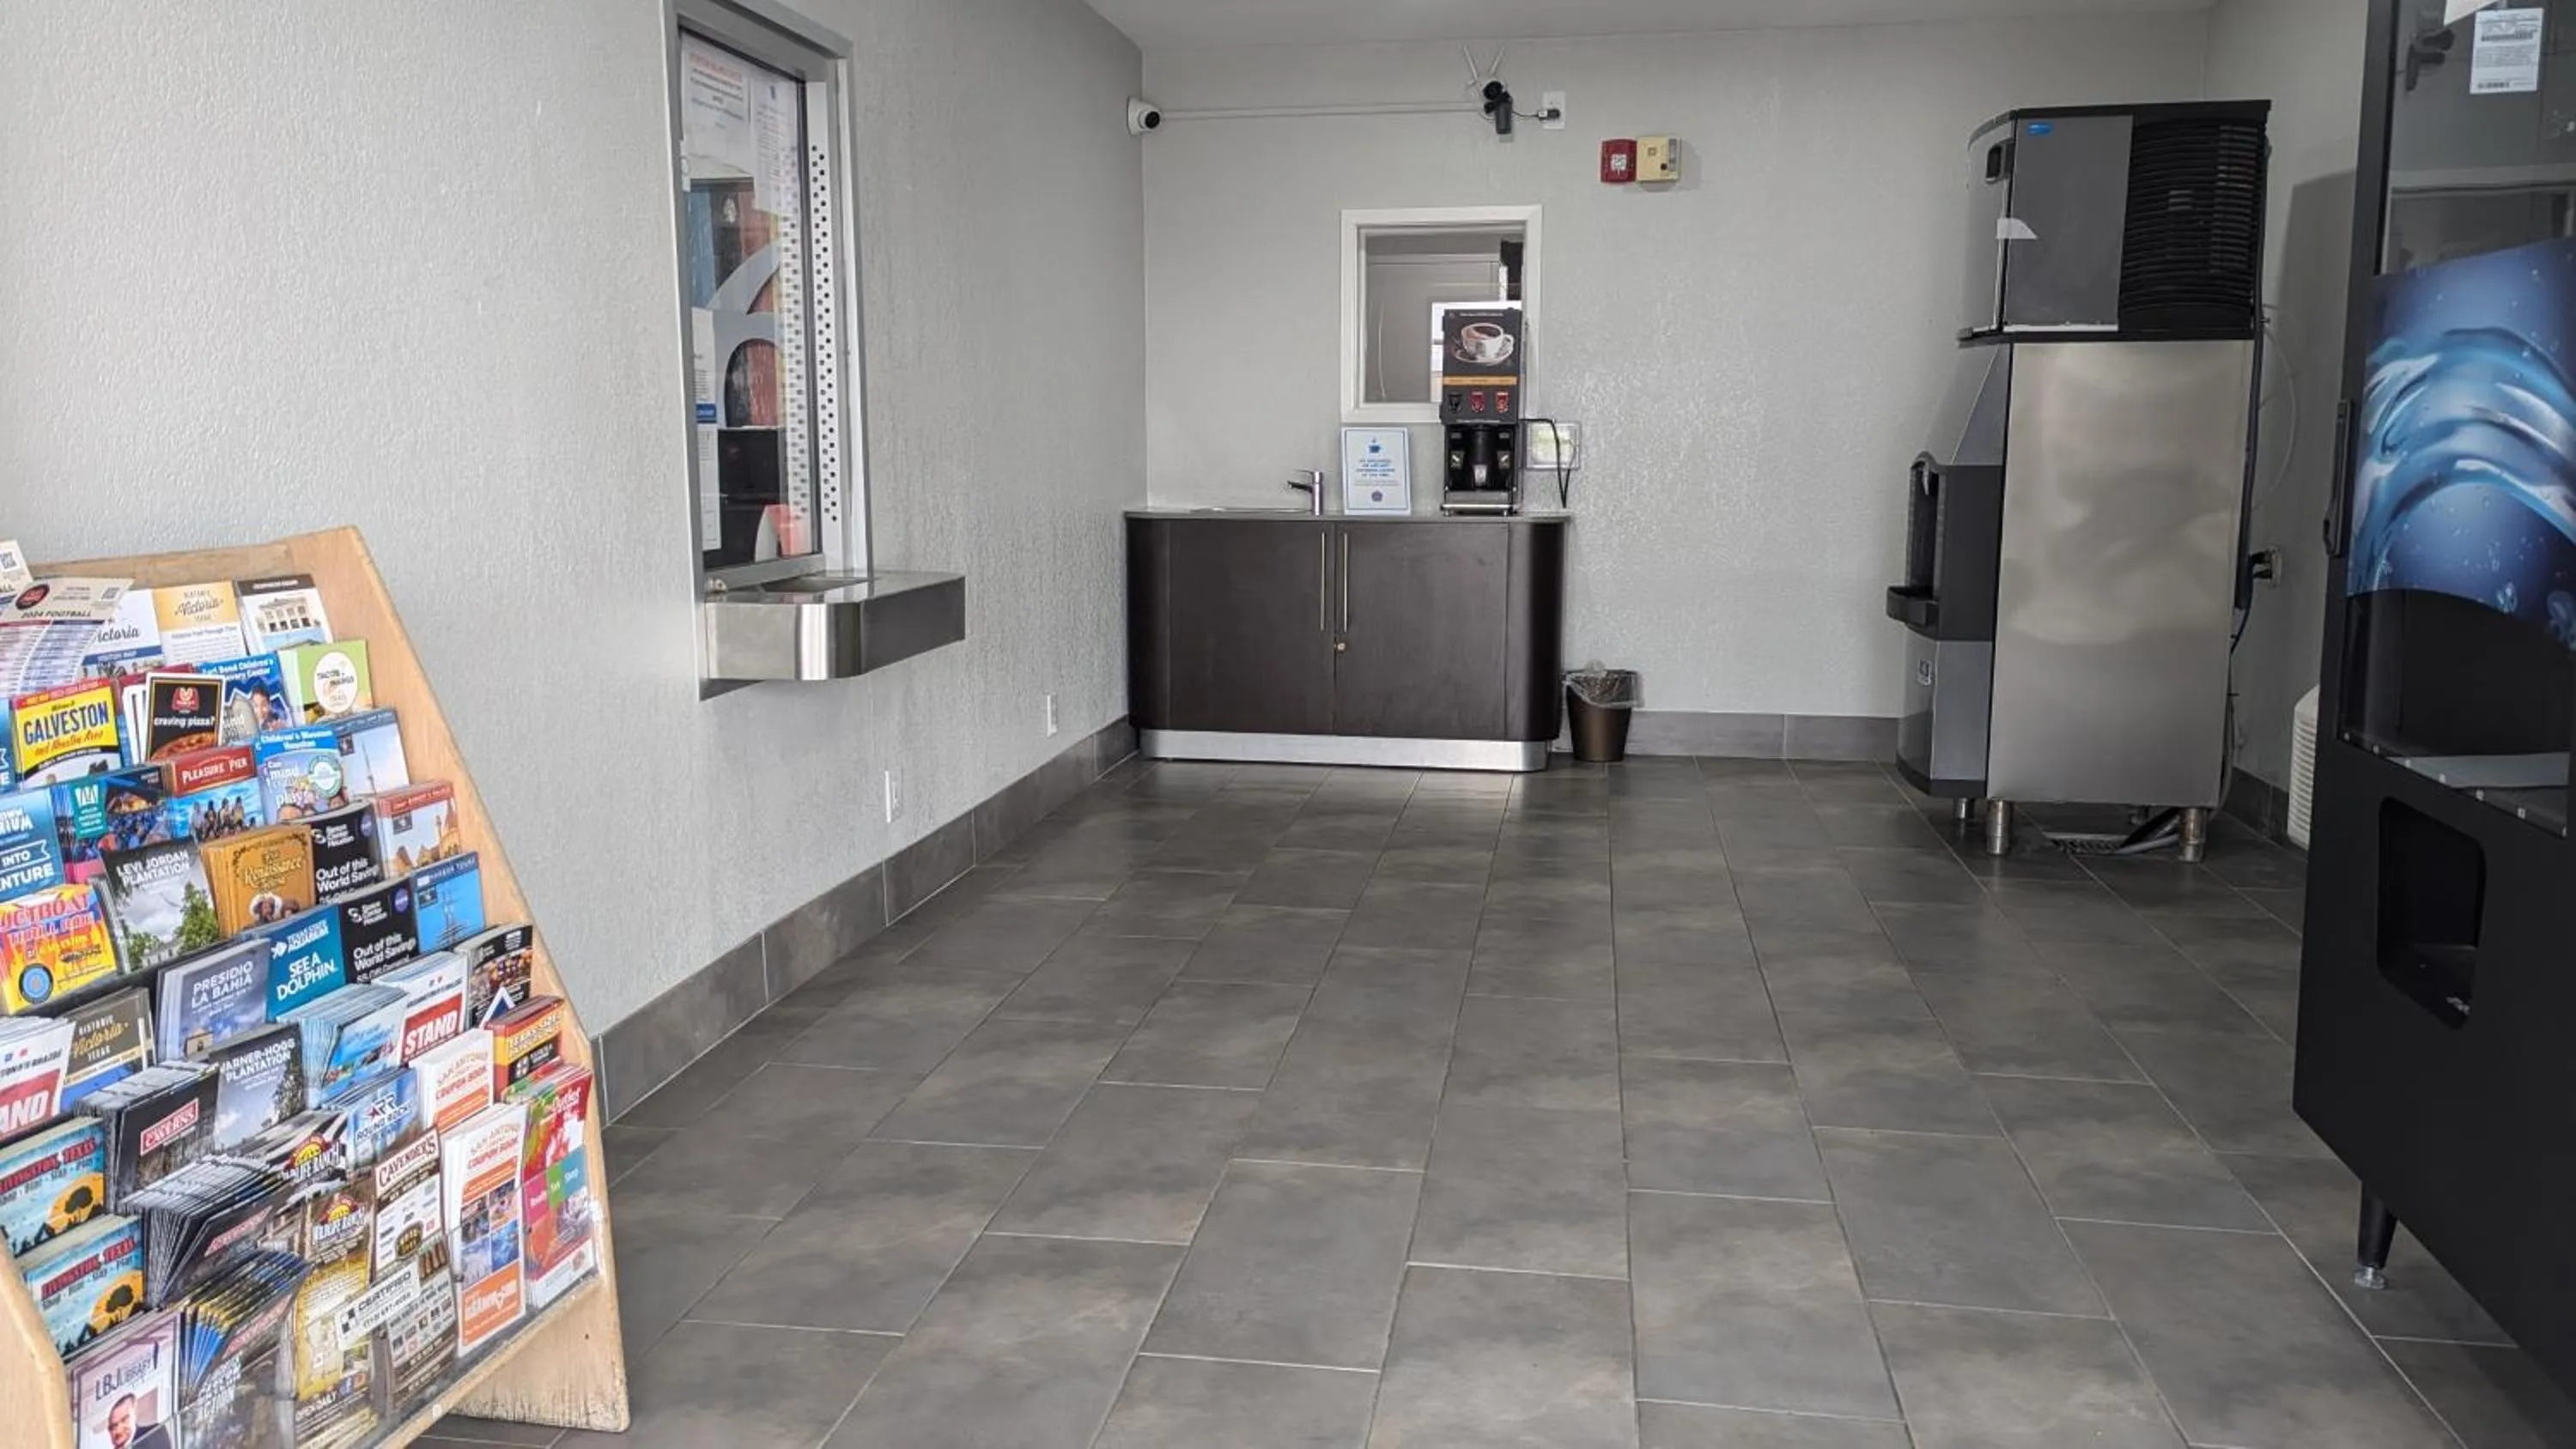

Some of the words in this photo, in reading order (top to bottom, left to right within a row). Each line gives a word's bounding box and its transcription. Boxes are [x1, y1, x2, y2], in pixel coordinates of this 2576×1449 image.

[23, 700, 109, 746] GALVESTON
[182, 761, 225, 785] PLEASURE
[229, 756, 247, 772] PIER
[116, 860, 143, 876] LEVI
[145, 849, 190, 870] JORDAN
[122, 861, 190, 888] PLANTATION
[316, 864, 337, 881] Out
[339, 861, 350, 875] of
[352, 858, 368, 872] this
[317, 873, 351, 894] World
[354, 943, 374, 961] Out
[374, 939, 385, 954] of
[385, 932, 403, 949] this
[289, 955, 311, 978] SEE
[311, 950, 322, 967] A
[354, 953, 385, 972] World
[193, 960, 253, 996] PRESIDIO
[191, 992, 210, 1009] LA
[404, 1009, 459, 1055] STAND
[226, 1051, 292, 1083] PLANTATION
